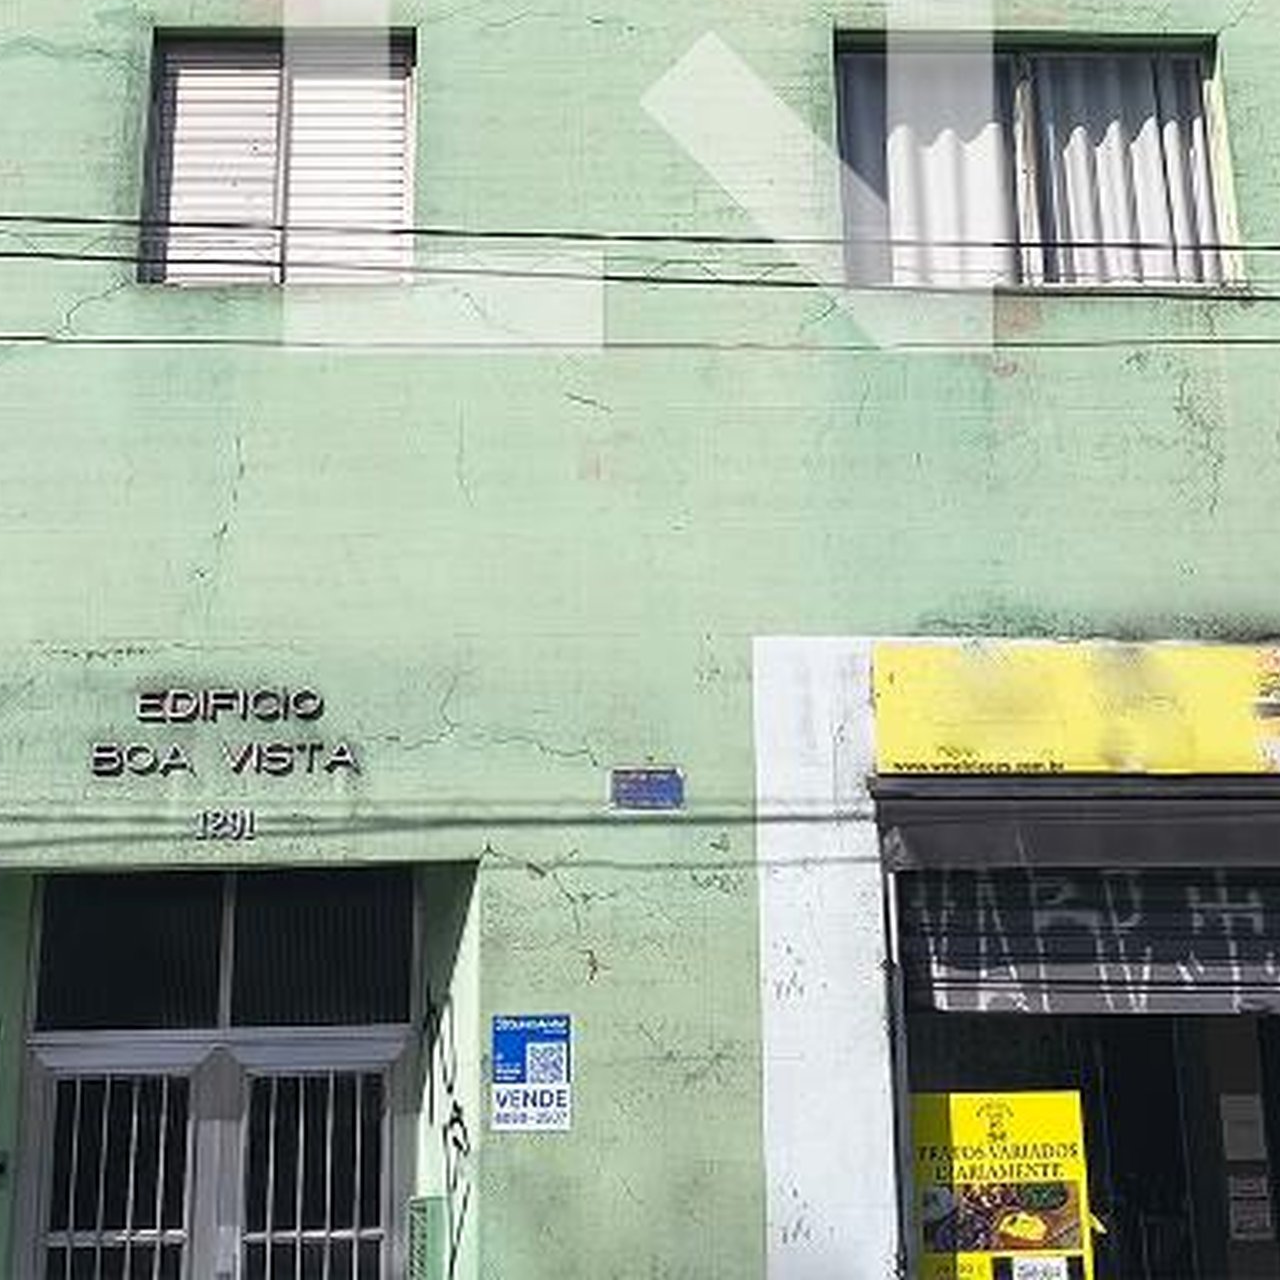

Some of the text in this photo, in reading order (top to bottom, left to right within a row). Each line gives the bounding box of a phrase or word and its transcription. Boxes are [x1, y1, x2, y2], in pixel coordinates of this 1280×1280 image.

[135, 689, 325, 724] EDIFICIO
[90, 741, 363, 778] BOA VISTA
[495, 1088, 568, 1109] VENDE
[989, 1142, 1079, 1161] VARIADOS
